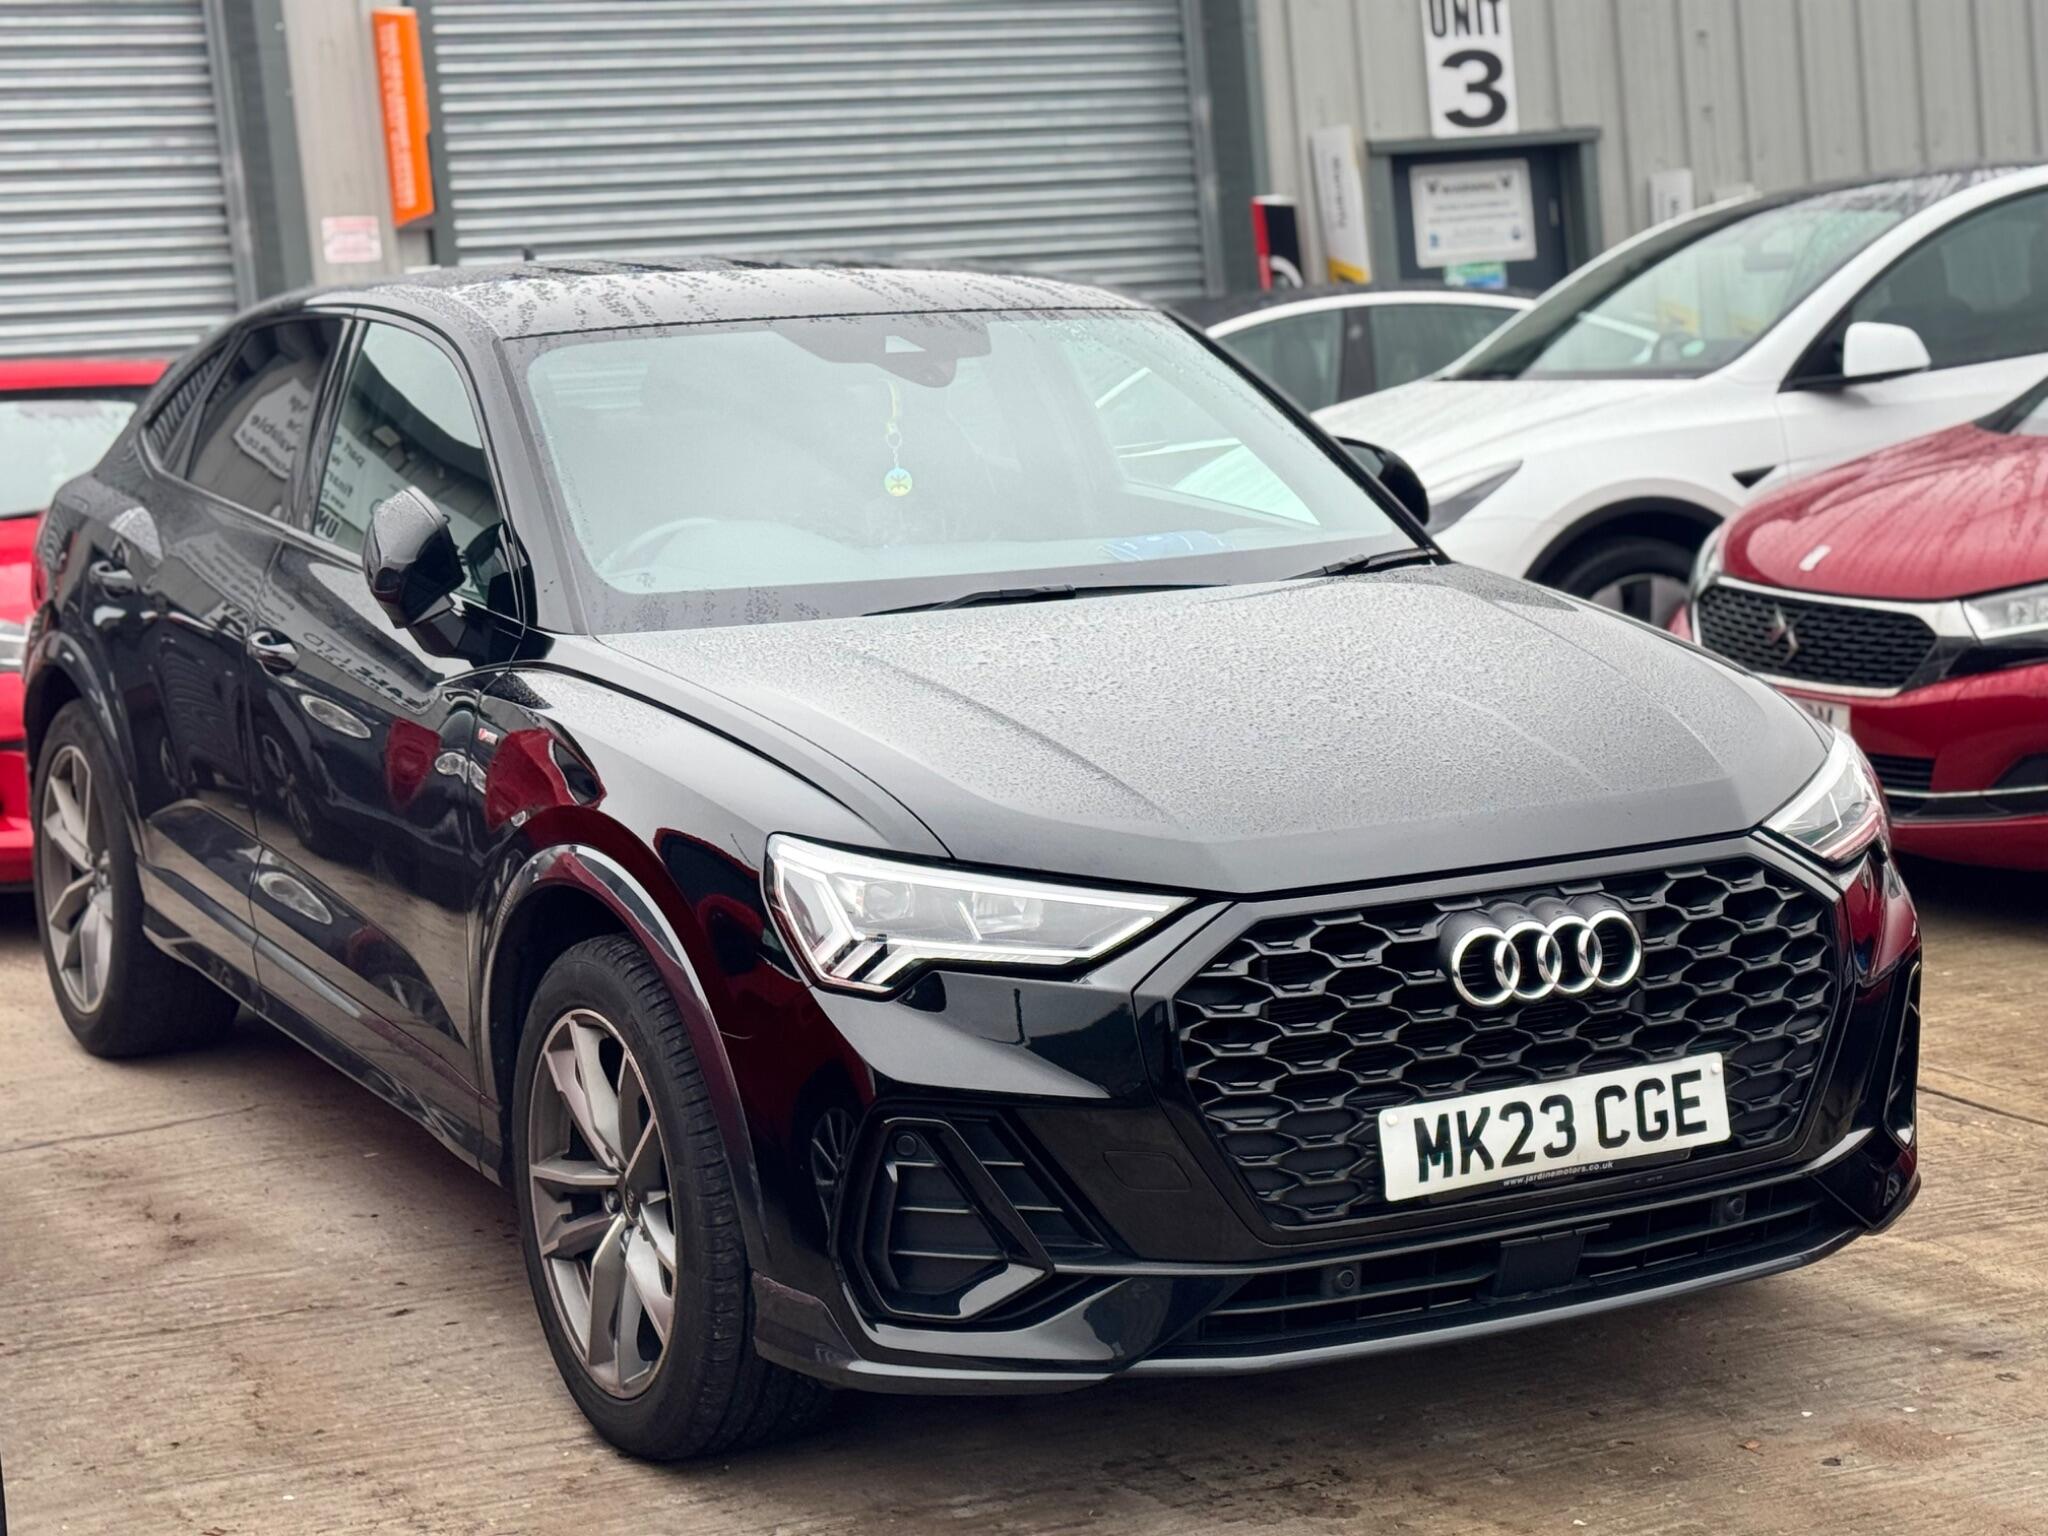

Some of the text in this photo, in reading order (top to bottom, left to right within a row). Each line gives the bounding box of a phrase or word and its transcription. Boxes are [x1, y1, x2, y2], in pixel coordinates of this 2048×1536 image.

[1428, 0, 1500, 38] UNIT
[1441, 49, 1508, 129] 3
[1412, 1068, 1708, 1184] MK23 CGE
[1503, 1160, 1614, 1186] www.jardinemotors.co.uk
